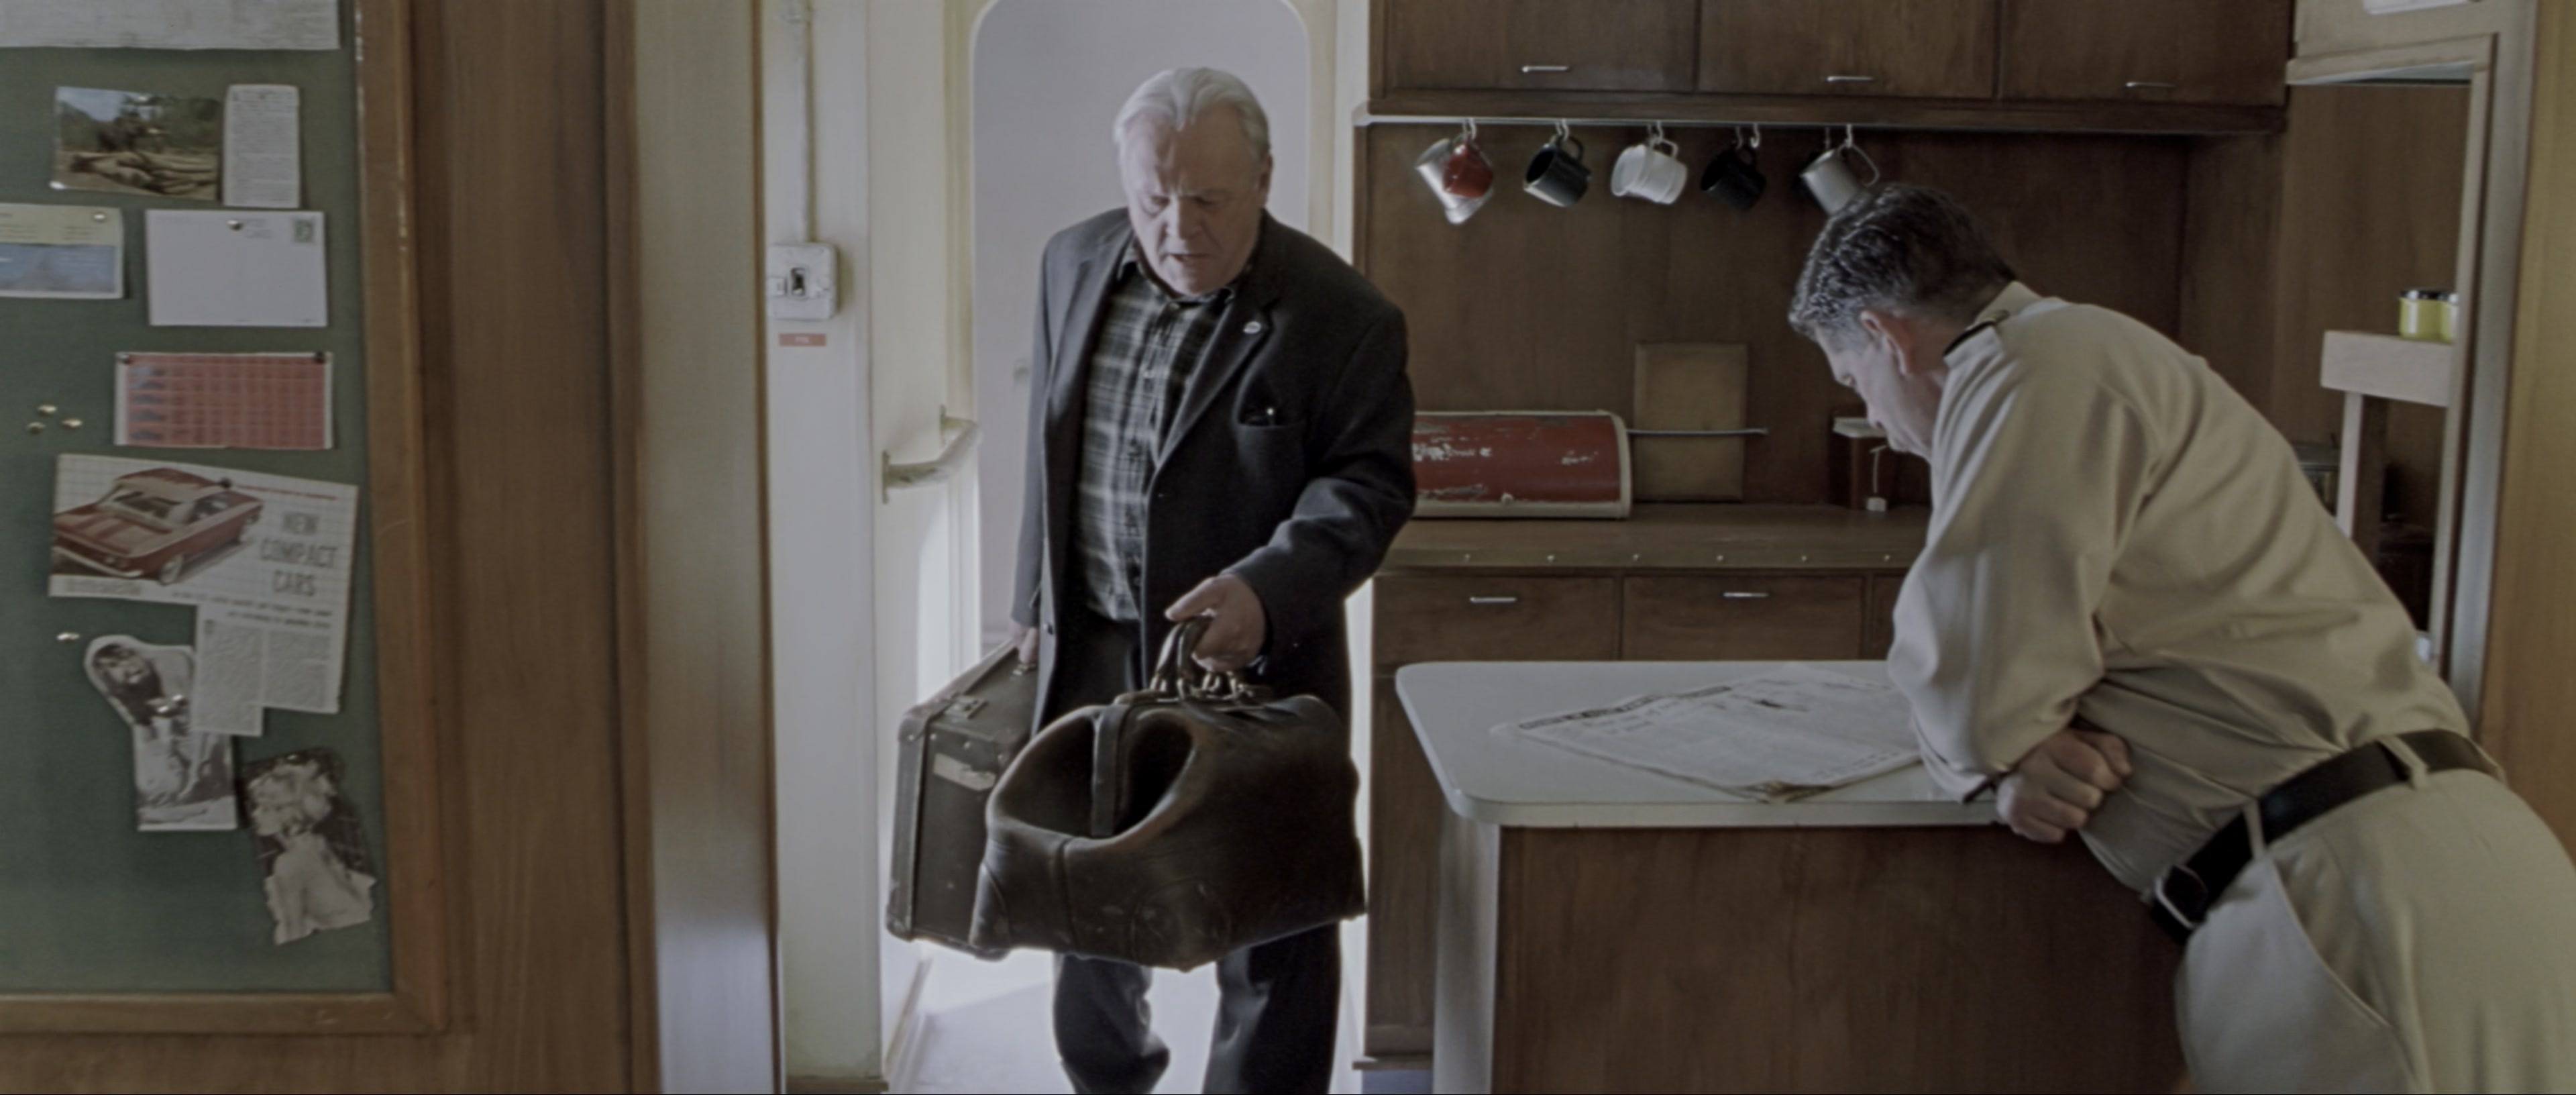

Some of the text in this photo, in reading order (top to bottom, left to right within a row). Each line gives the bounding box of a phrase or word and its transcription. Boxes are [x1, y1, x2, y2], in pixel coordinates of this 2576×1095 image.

[282, 512, 319, 535] NEW
[262, 537, 338, 568] COMPACT
[273, 570, 316, 596] CARS
